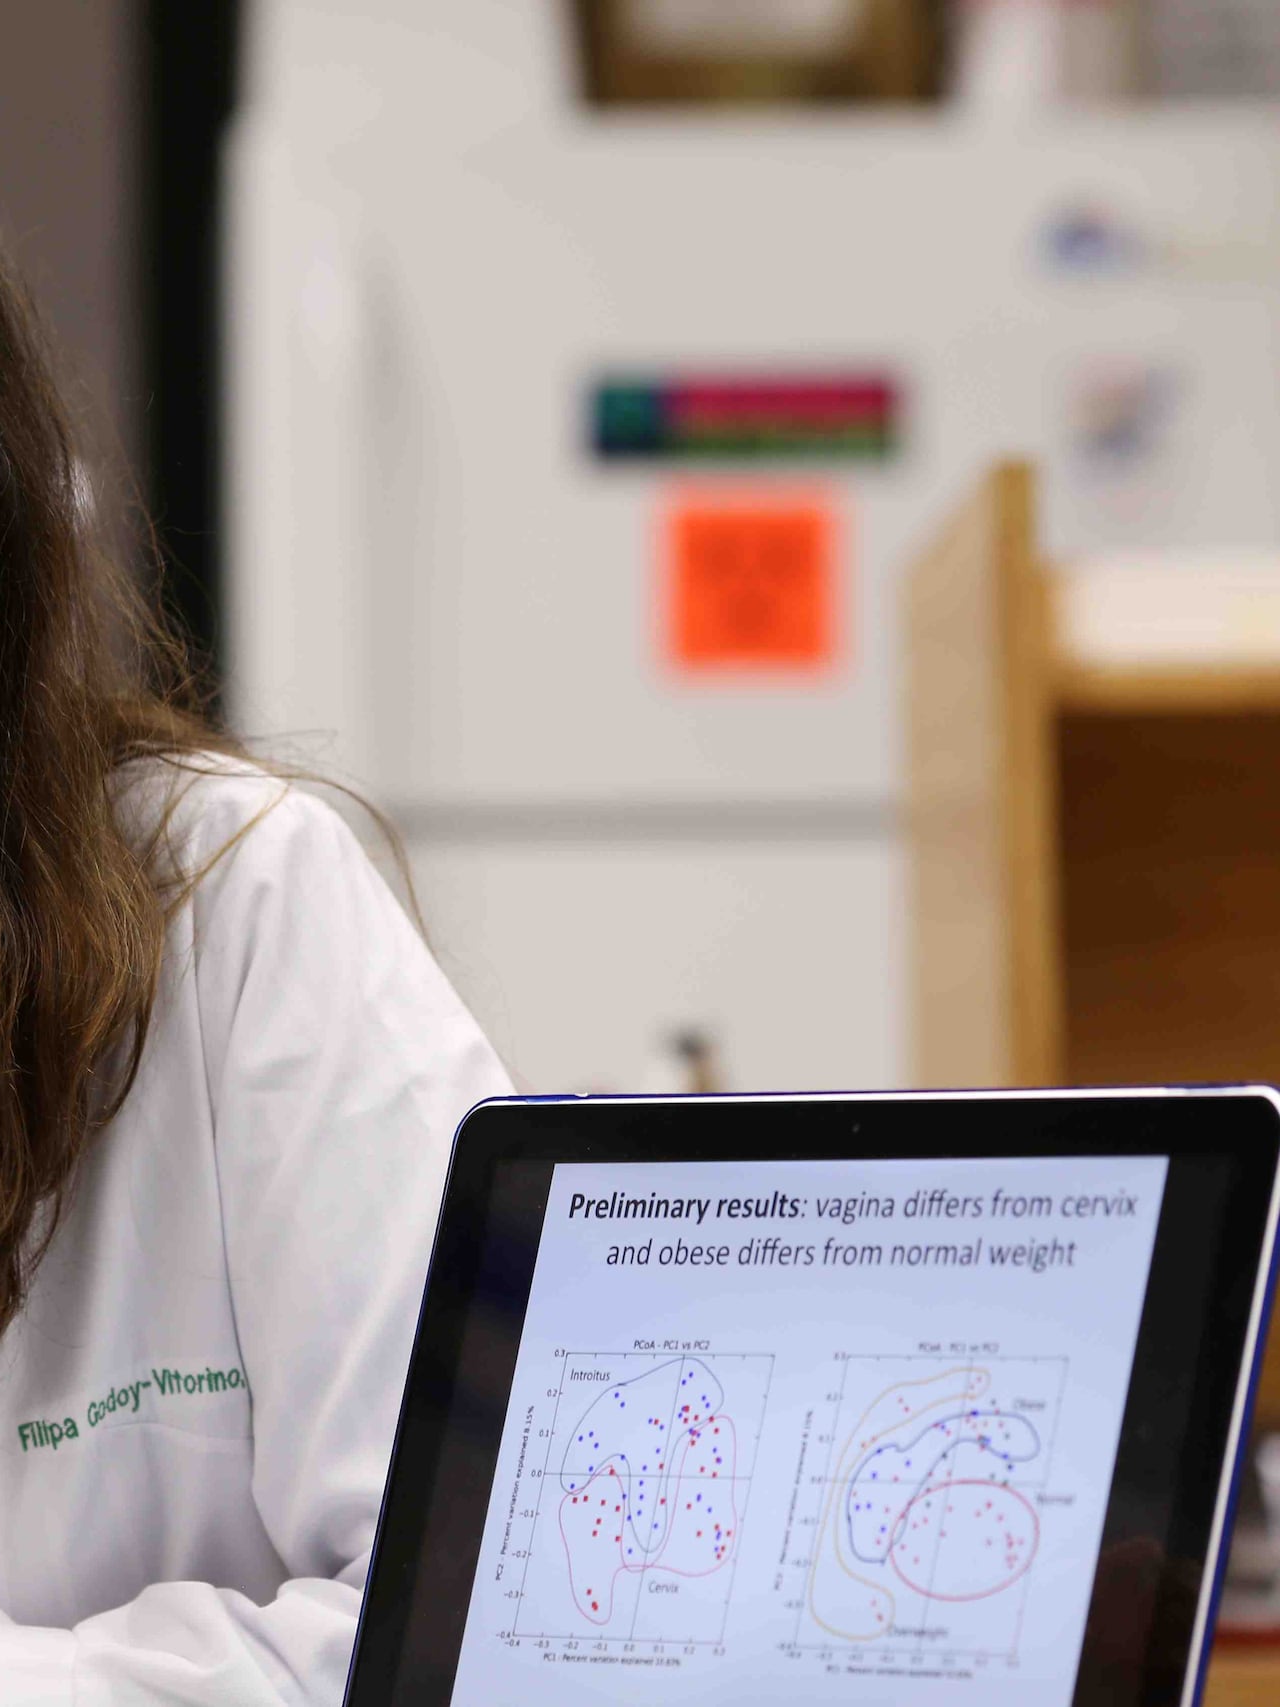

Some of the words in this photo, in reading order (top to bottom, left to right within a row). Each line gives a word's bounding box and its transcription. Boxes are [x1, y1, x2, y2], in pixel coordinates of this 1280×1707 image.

[569, 1192, 710, 1225] Preliminary
[716, 1190, 808, 1219] results:
[816, 1191, 896, 1224] vagina
[903, 1189, 984, 1219] differs
[990, 1187, 1053, 1219] from
[1060, 1189, 1138, 1218] cervix
[606, 1238, 653, 1265] and
[658, 1238, 730, 1266] obese
[738, 1237, 815, 1266] differs
[822, 1237, 882, 1266] from
[890, 1237, 982, 1267] normal
[989, 1237, 1077, 1273] weight
[570, 1368, 610, 1382] Introitus
[18, 1417, 79, 1452] Filipa
